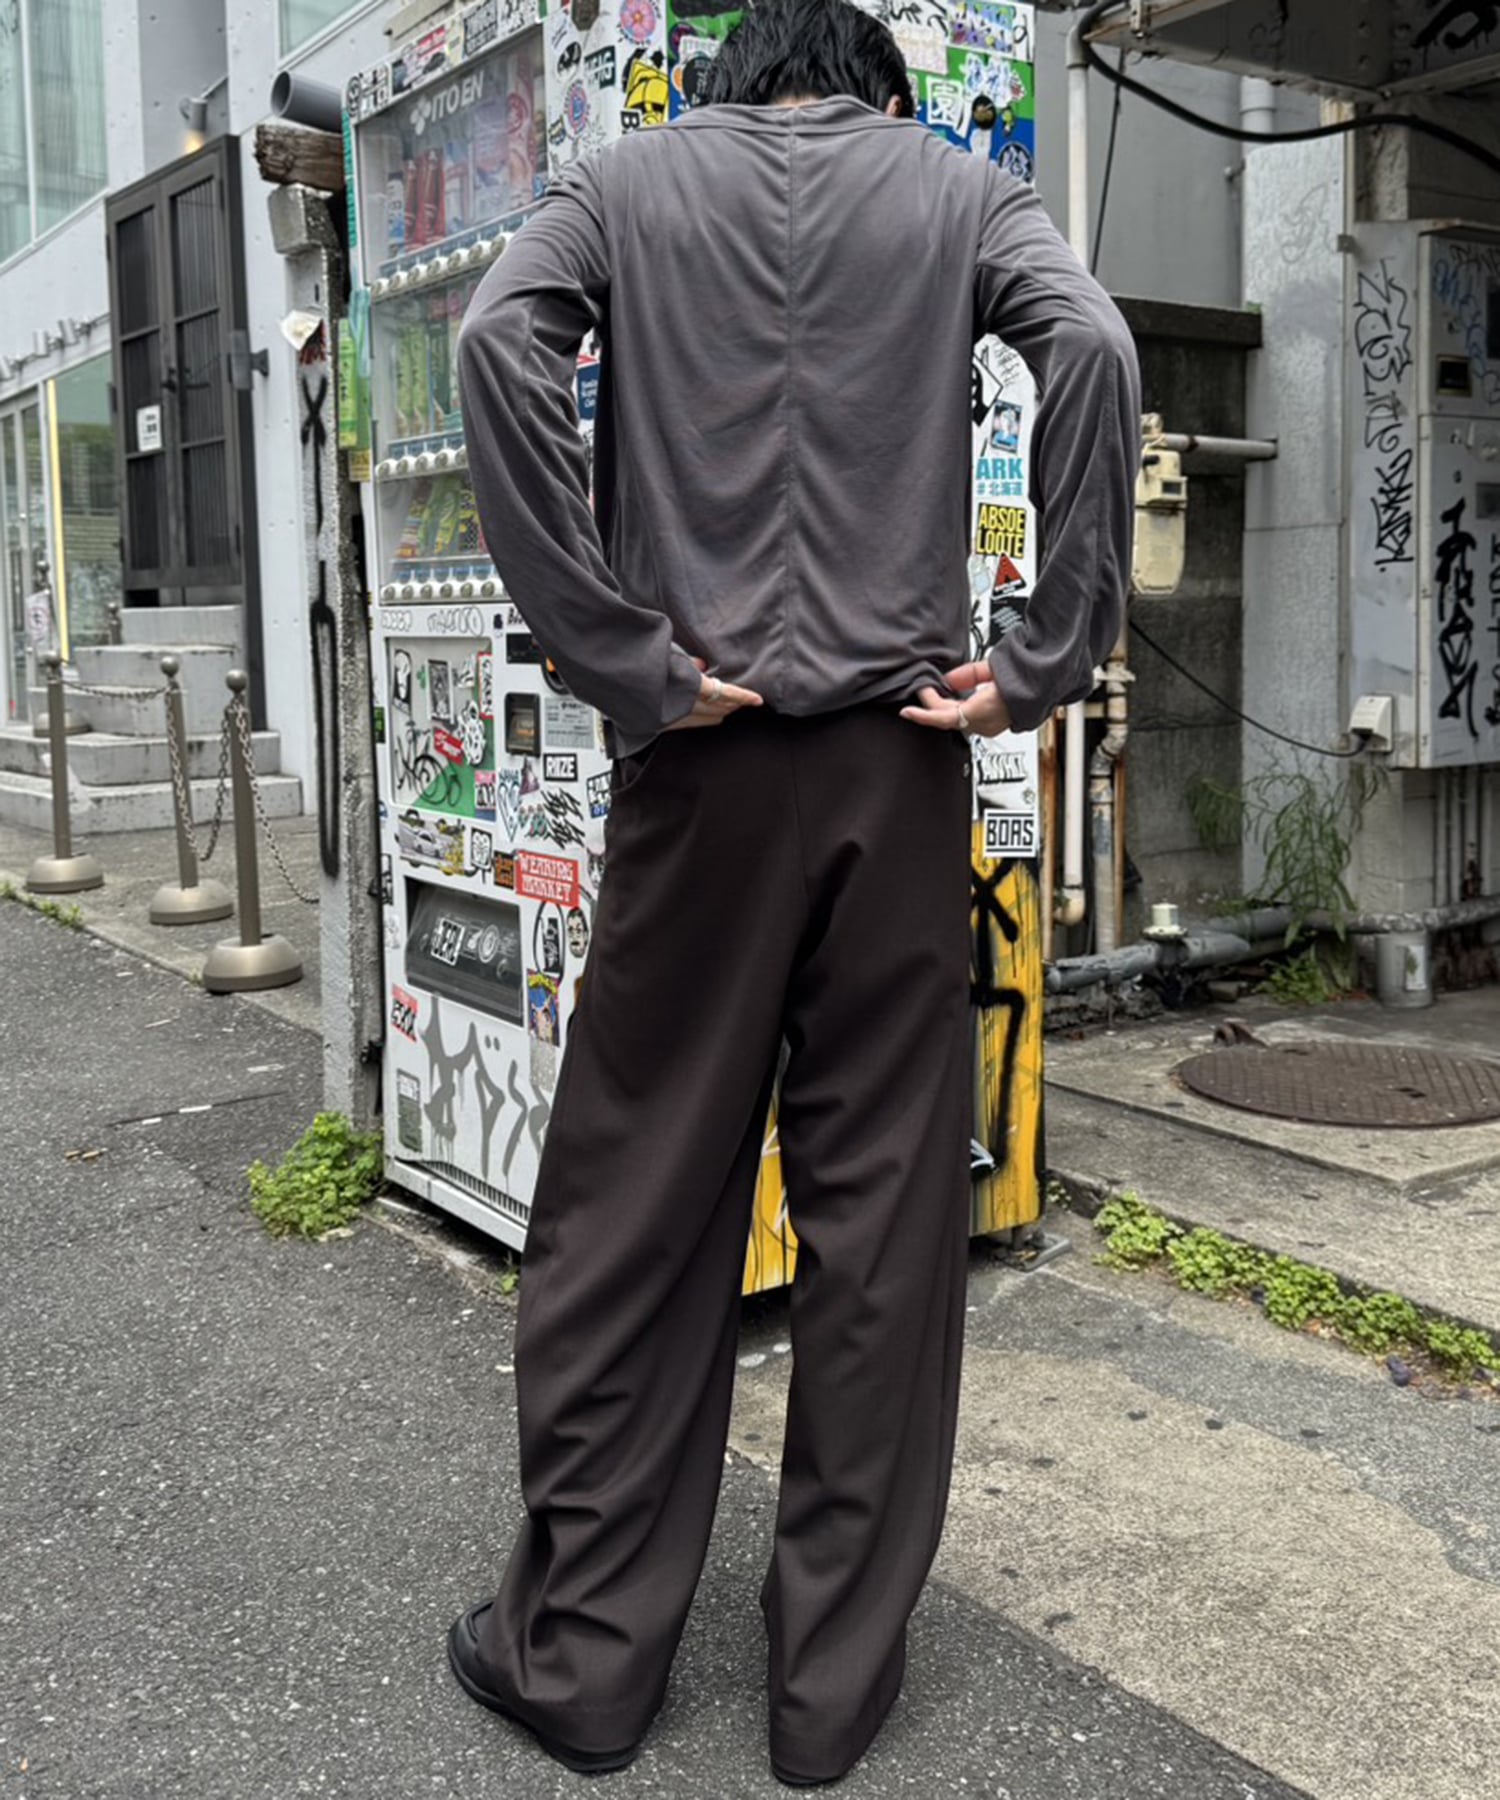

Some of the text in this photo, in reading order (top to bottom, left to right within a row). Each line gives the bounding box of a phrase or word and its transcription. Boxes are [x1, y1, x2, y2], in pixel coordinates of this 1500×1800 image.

[462, 69, 484, 104] EN
[976, 457, 1024, 479] ARK
[978, 503, 1025, 534] ABSOE
[975, 528, 1025, 559] LOOTE
